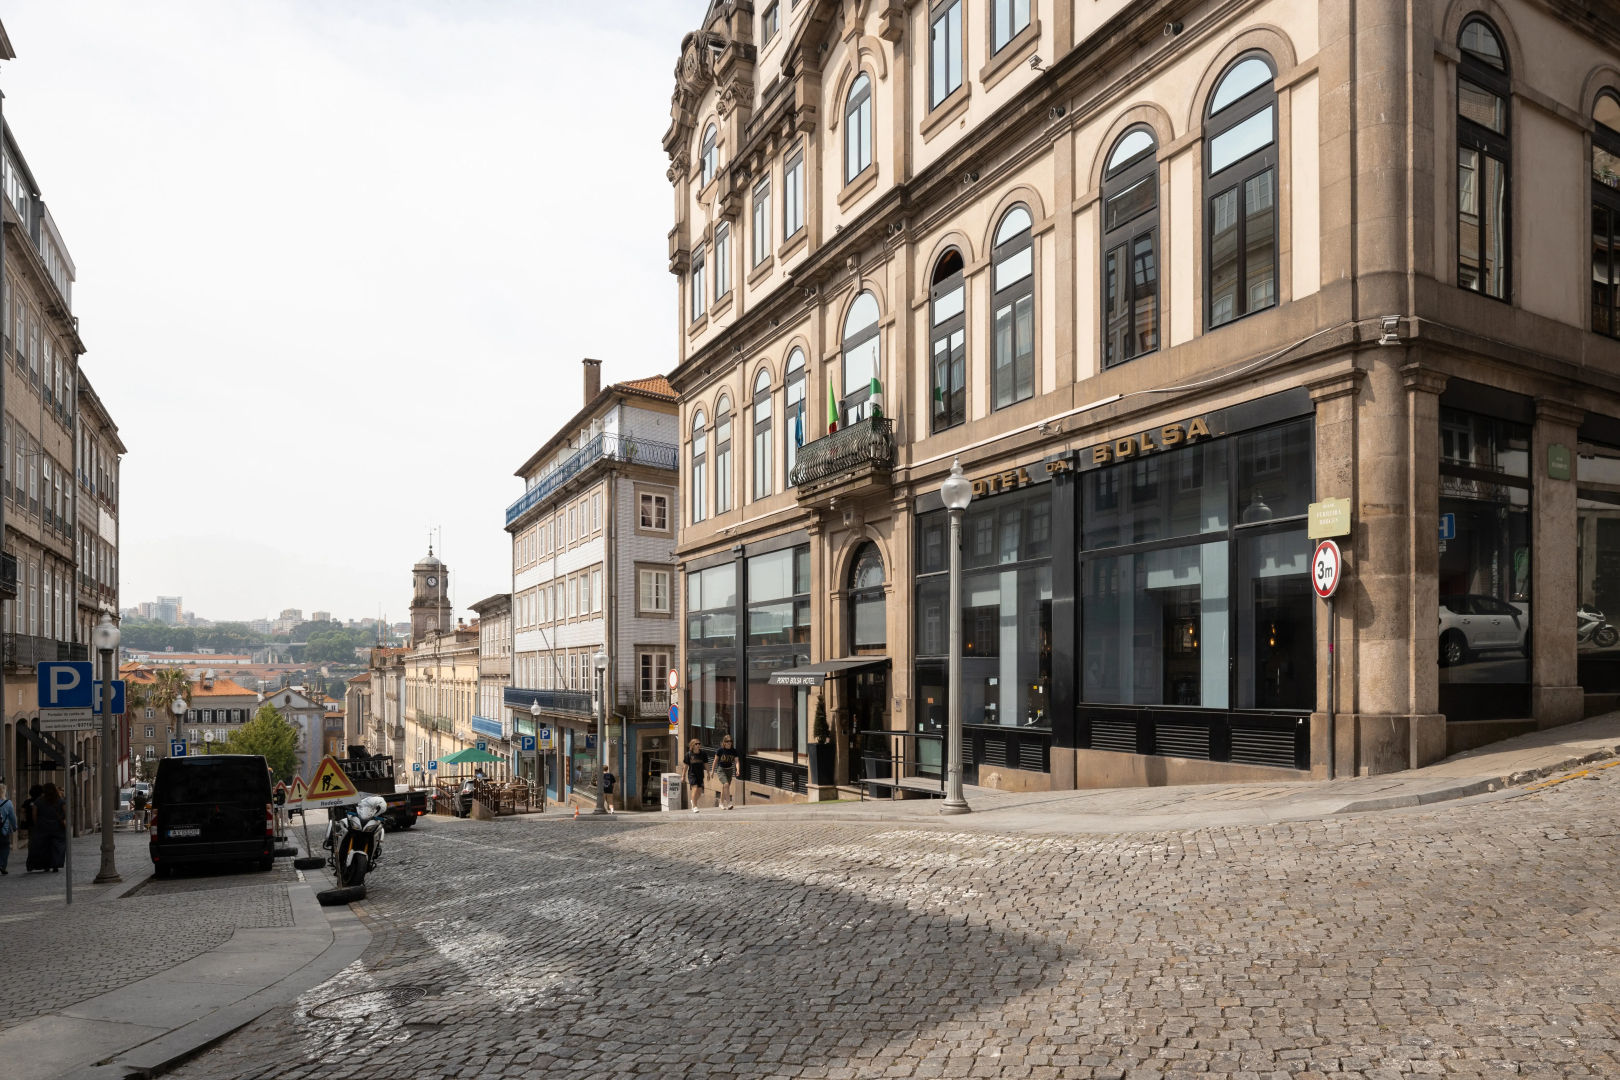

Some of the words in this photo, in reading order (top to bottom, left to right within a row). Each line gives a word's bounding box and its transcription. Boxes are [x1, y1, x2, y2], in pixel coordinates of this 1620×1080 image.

[972, 468, 1032, 495] OTEL
[1045, 460, 1069, 473] DA
[1093, 418, 1211, 464] BOLSA
[1316, 509, 1342, 519] FERREIRA
[1319, 517, 1339, 526] BORGES
[1317, 561, 1333, 579] 3m
[50, 666, 80, 703] P
[803, 677, 815, 685] HOTEL
[94, 684, 116, 711] P
[524, 738, 533, 749] P
[174, 744, 183, 756] P
